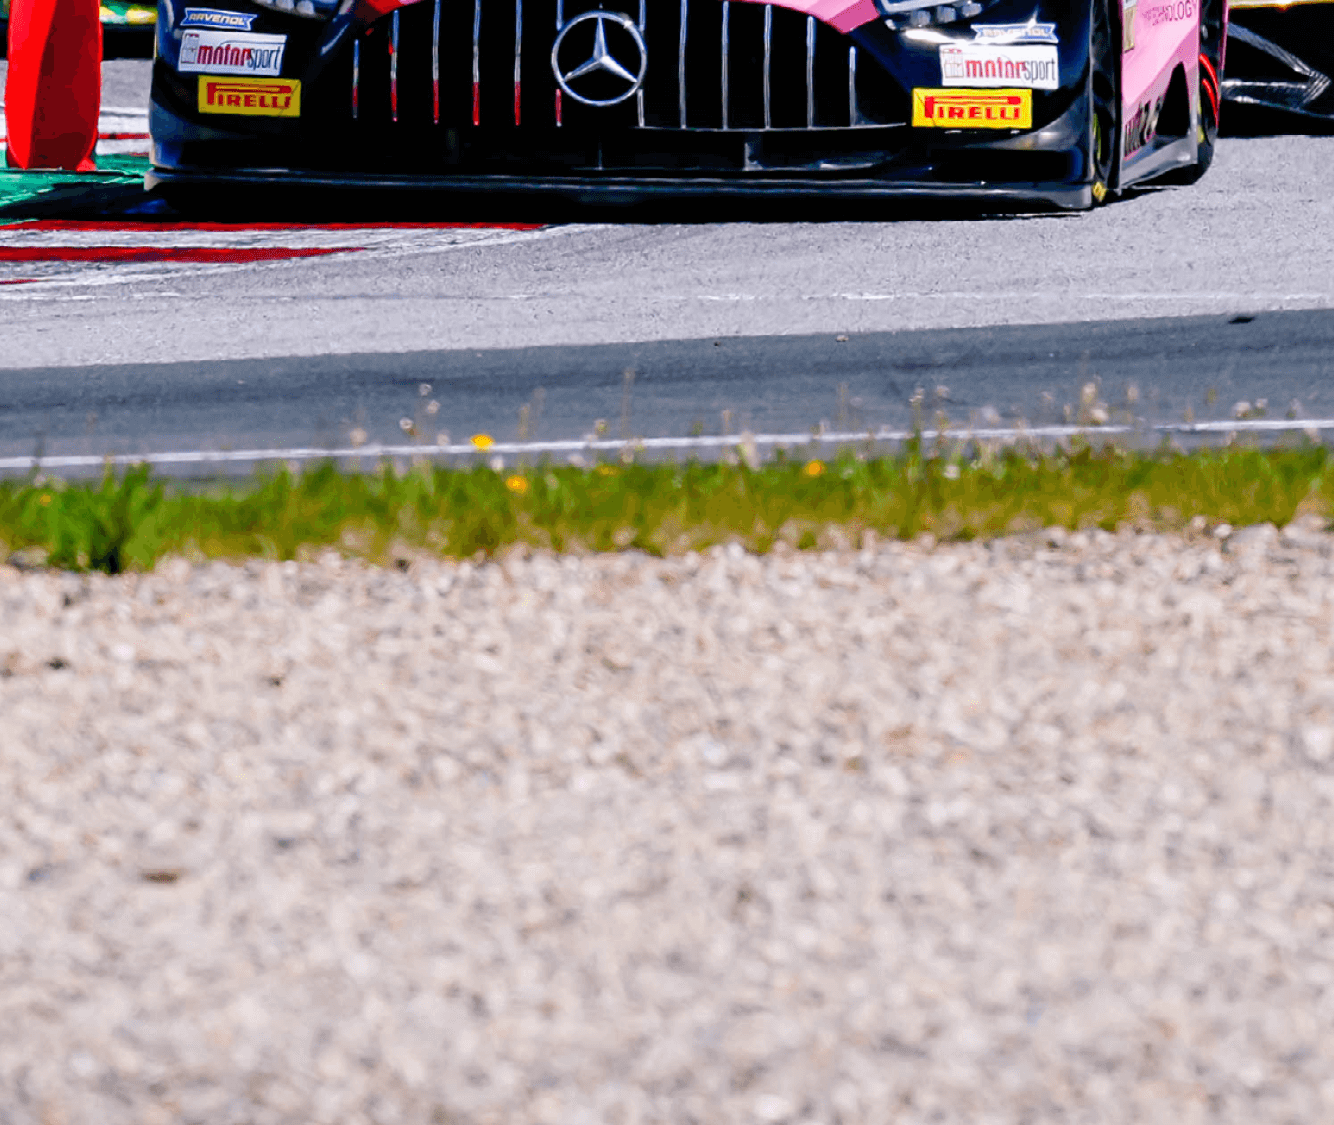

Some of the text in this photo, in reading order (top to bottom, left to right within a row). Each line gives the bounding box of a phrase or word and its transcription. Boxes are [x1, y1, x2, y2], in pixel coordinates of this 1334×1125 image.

[189, 12, 245, 25] RAVENOL
[197, 45, 280, 70] motorsport
[965, 57, 1056, 82] motorsport
[206, 82, 292, 108] PIRELLI
[924, 96, 1021, 119] PIRELLI
